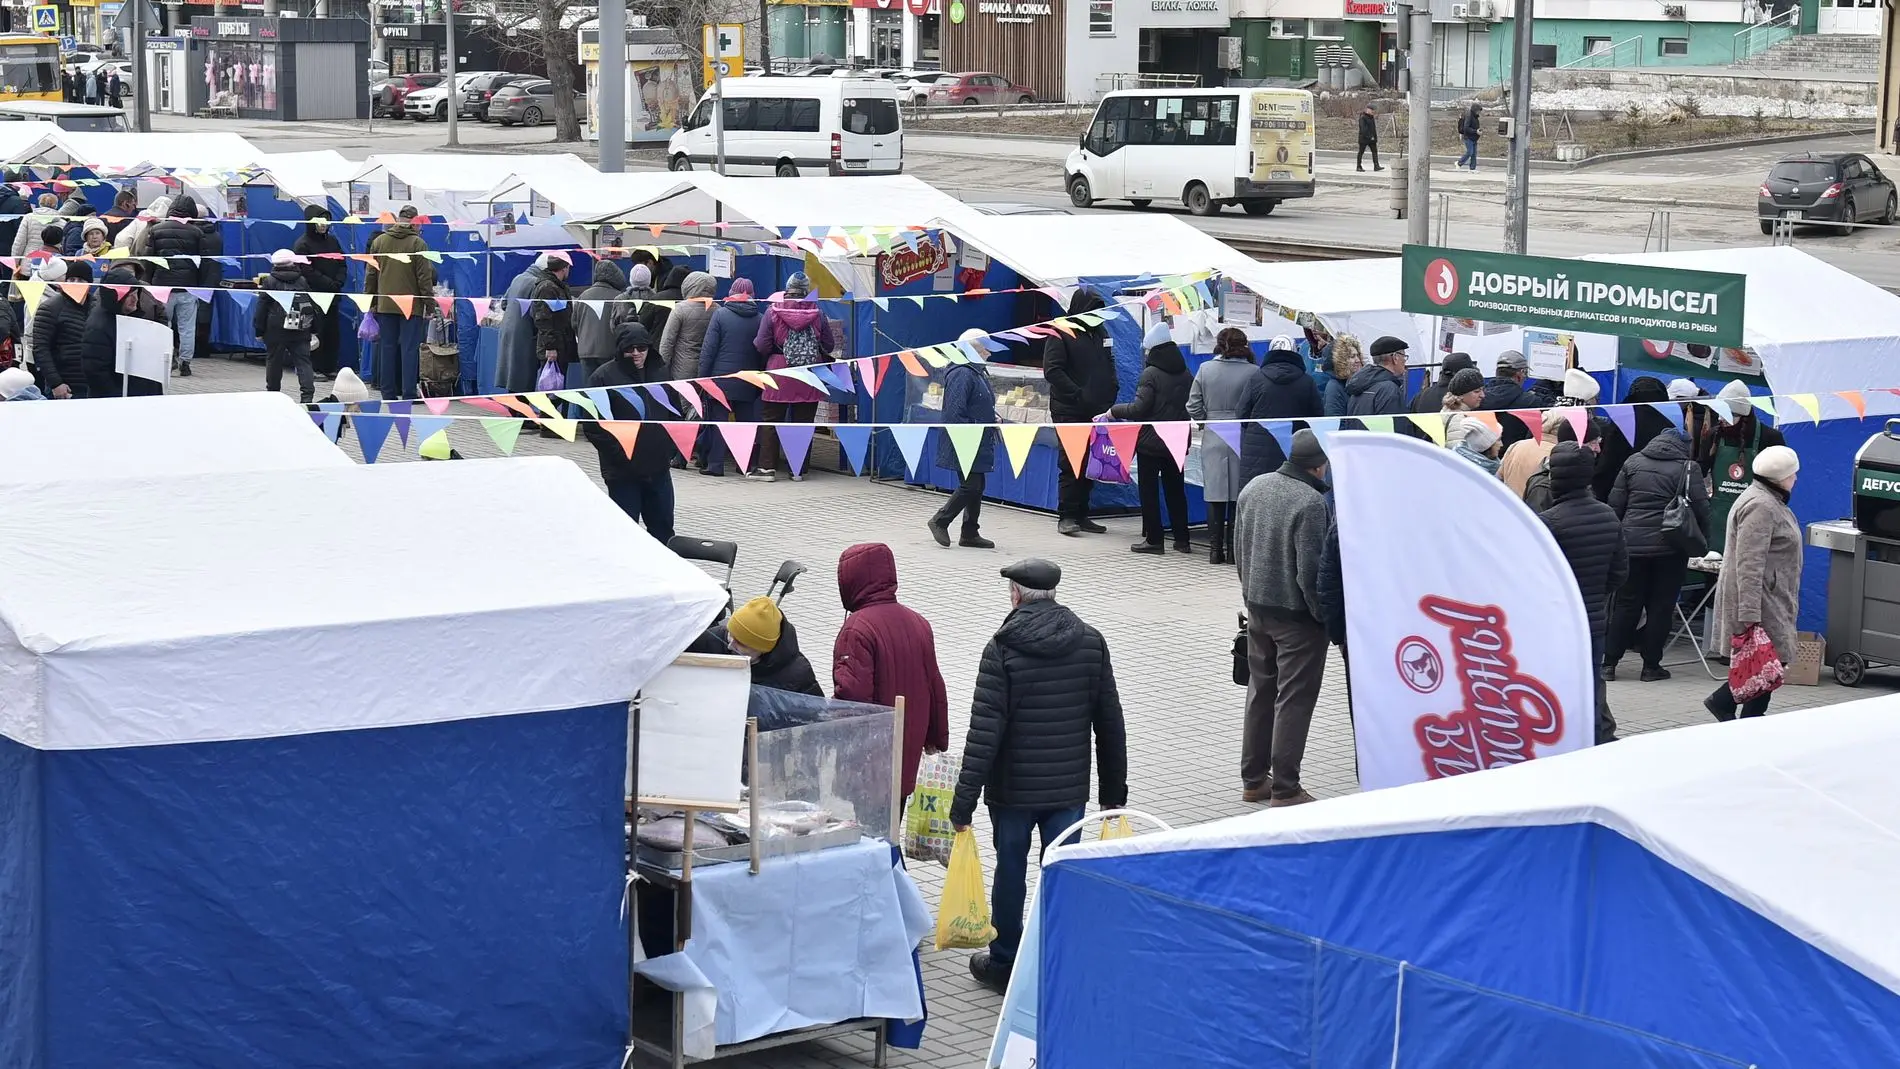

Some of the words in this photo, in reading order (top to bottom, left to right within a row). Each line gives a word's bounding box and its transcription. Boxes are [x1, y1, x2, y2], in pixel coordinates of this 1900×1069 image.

[980, 3, 1011, 13] ВИЛКА
[1015, 4, 1051, 15] ЛОЖКА
[1152, 1, 1182, 11] ВИЛКА
[1185, 1, 1218, 11] ЛОЖКА
[1346, 0, 1397, 14] Красное&Б
[218, 22, 250, 37] ЦВЕТЫ
[383, 27, 408, 37] ФРУКТЫ
[146, 41, 177, 49] РОСПЕЧАТЬ
[1259, 103, 1277, 111] DENT
[1469, 271, 1569, 300] ДОБРЫЙ
[1577, 281, 1718, 315] ПРОМЫСЕЛ
[1469, 300, 1527, 313] ПРОИЗВОДСТВО
[1529, 306, 1563, 318] РЫБНЫХ
[1564, 309, 1620, 323] ДЕЛИКАТЕСОВ
[1629, 317, 1677, 329] ПРОДУКТОВ
[1679, 322, 1690, 330] ИЗ
[1691, 323, 1717, 333] РЫБЫ
[1102, 445, 1116, 456] WB
[1722, 480, 1749, 488] ДОБРЫЙ
